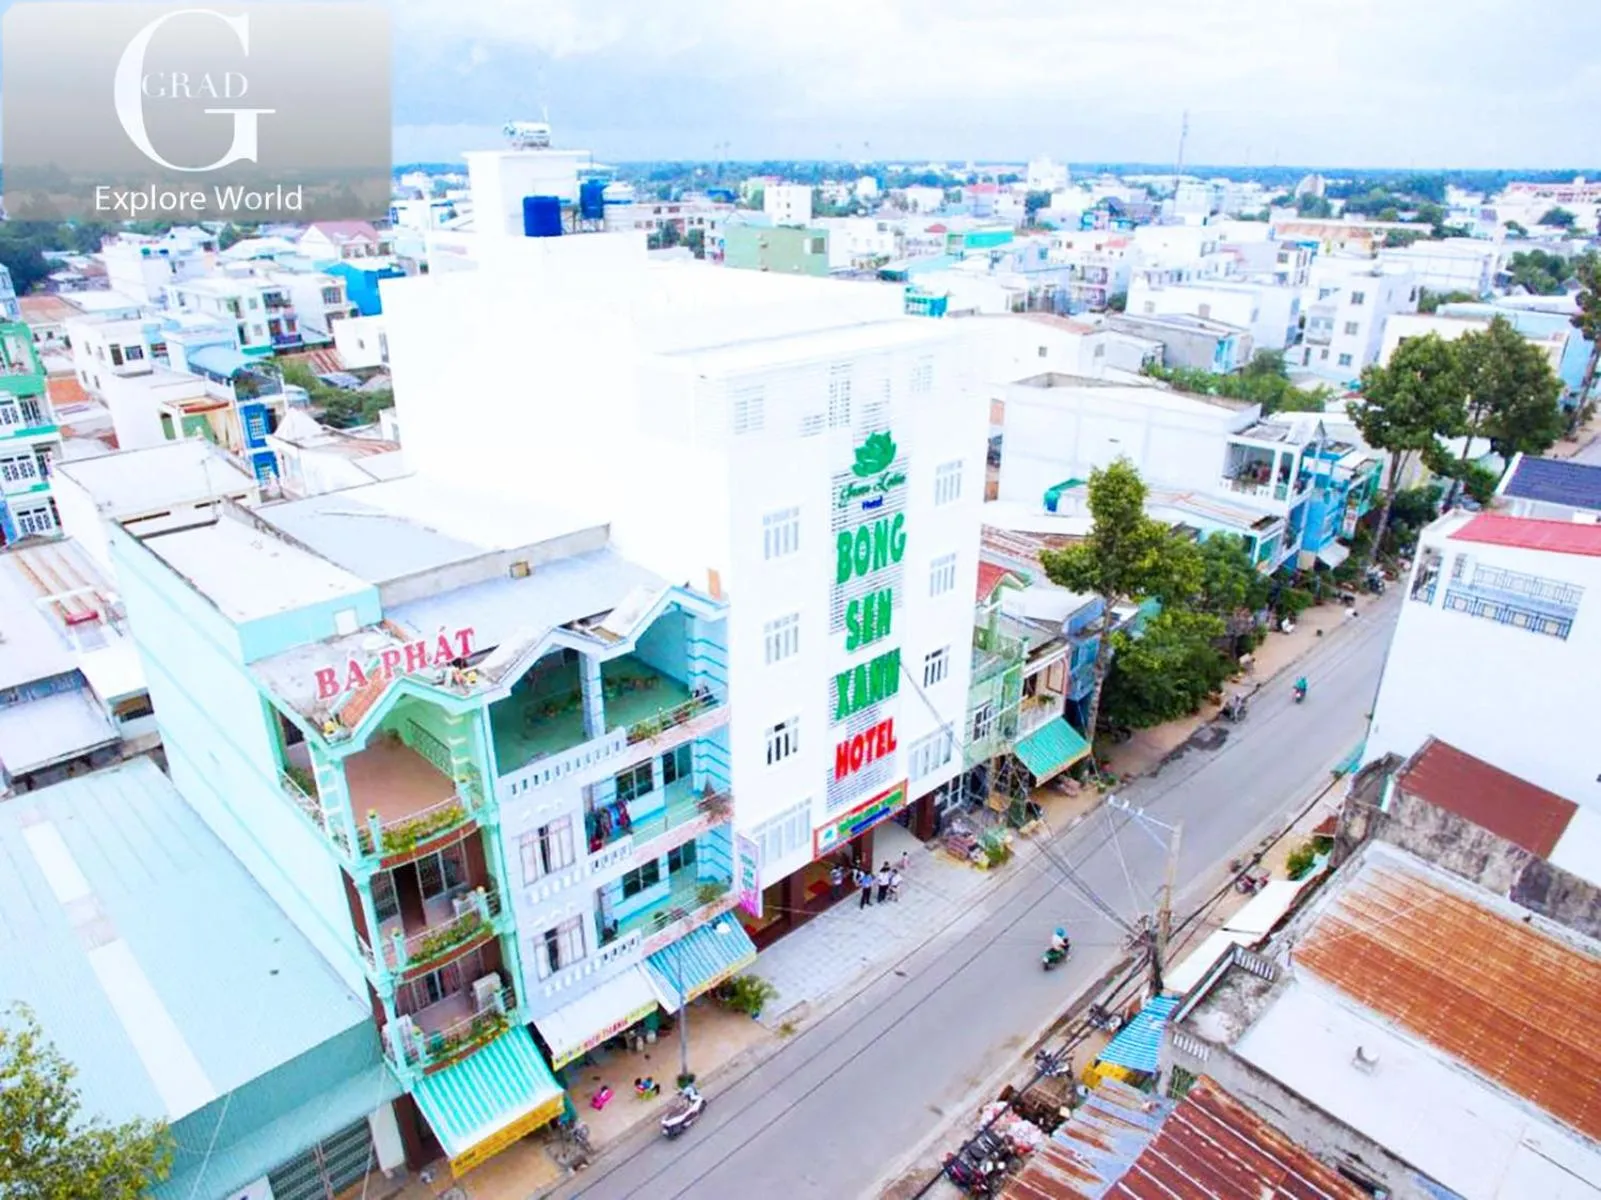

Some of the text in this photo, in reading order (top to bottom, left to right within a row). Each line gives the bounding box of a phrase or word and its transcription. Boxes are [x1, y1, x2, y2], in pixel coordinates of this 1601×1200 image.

[845, 587, 893, 652] SEN
[315, 626, 475, 700] BA PHÁT
[835, 647, 901, 721] XANH
[834, 716, 897, 782] HOTEL
